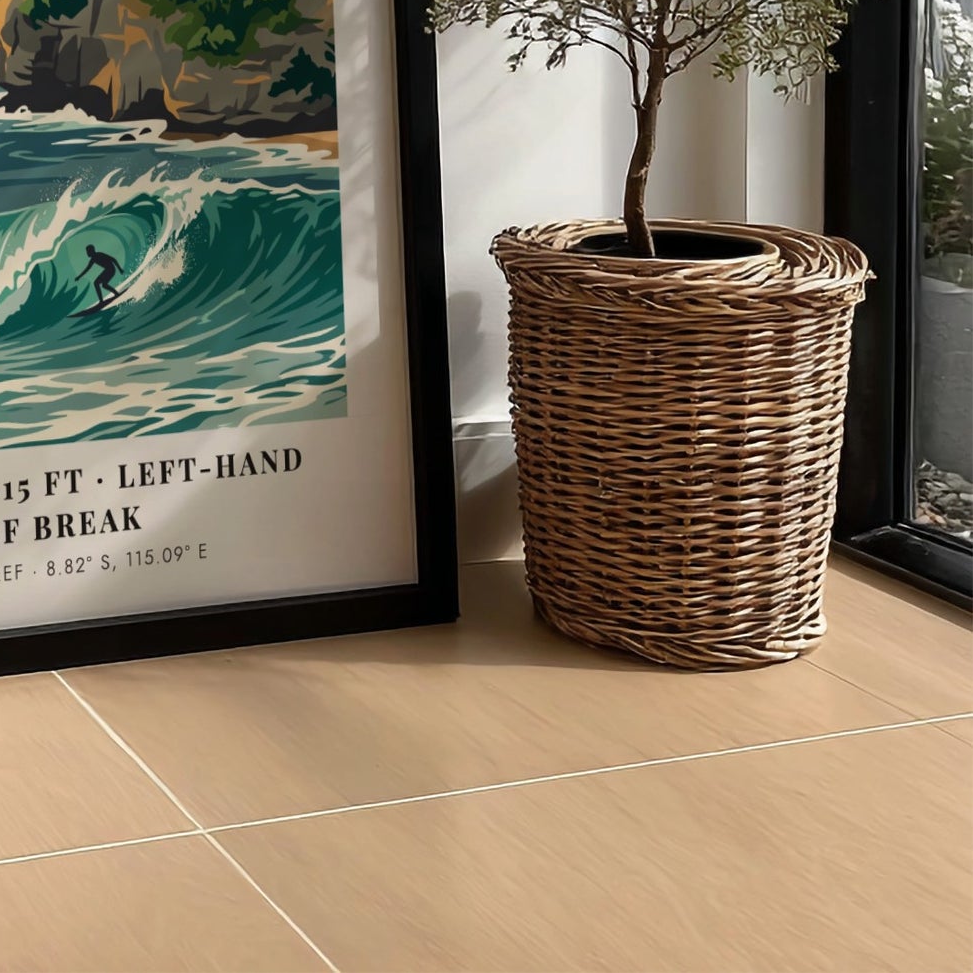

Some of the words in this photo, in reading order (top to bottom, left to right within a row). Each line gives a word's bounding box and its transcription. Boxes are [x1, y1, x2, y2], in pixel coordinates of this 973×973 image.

[43, 467, 83, 497] FT
[117, 447, 302, 490] LEFT-HAND
[32, 505, 142, 542] BREAK
[46, 555, 92, 577] 8.82°
[100, 554, 117, 572] S,
[126, 544, 191, 567] 115.09°
[198, 542, 207, 560] E
